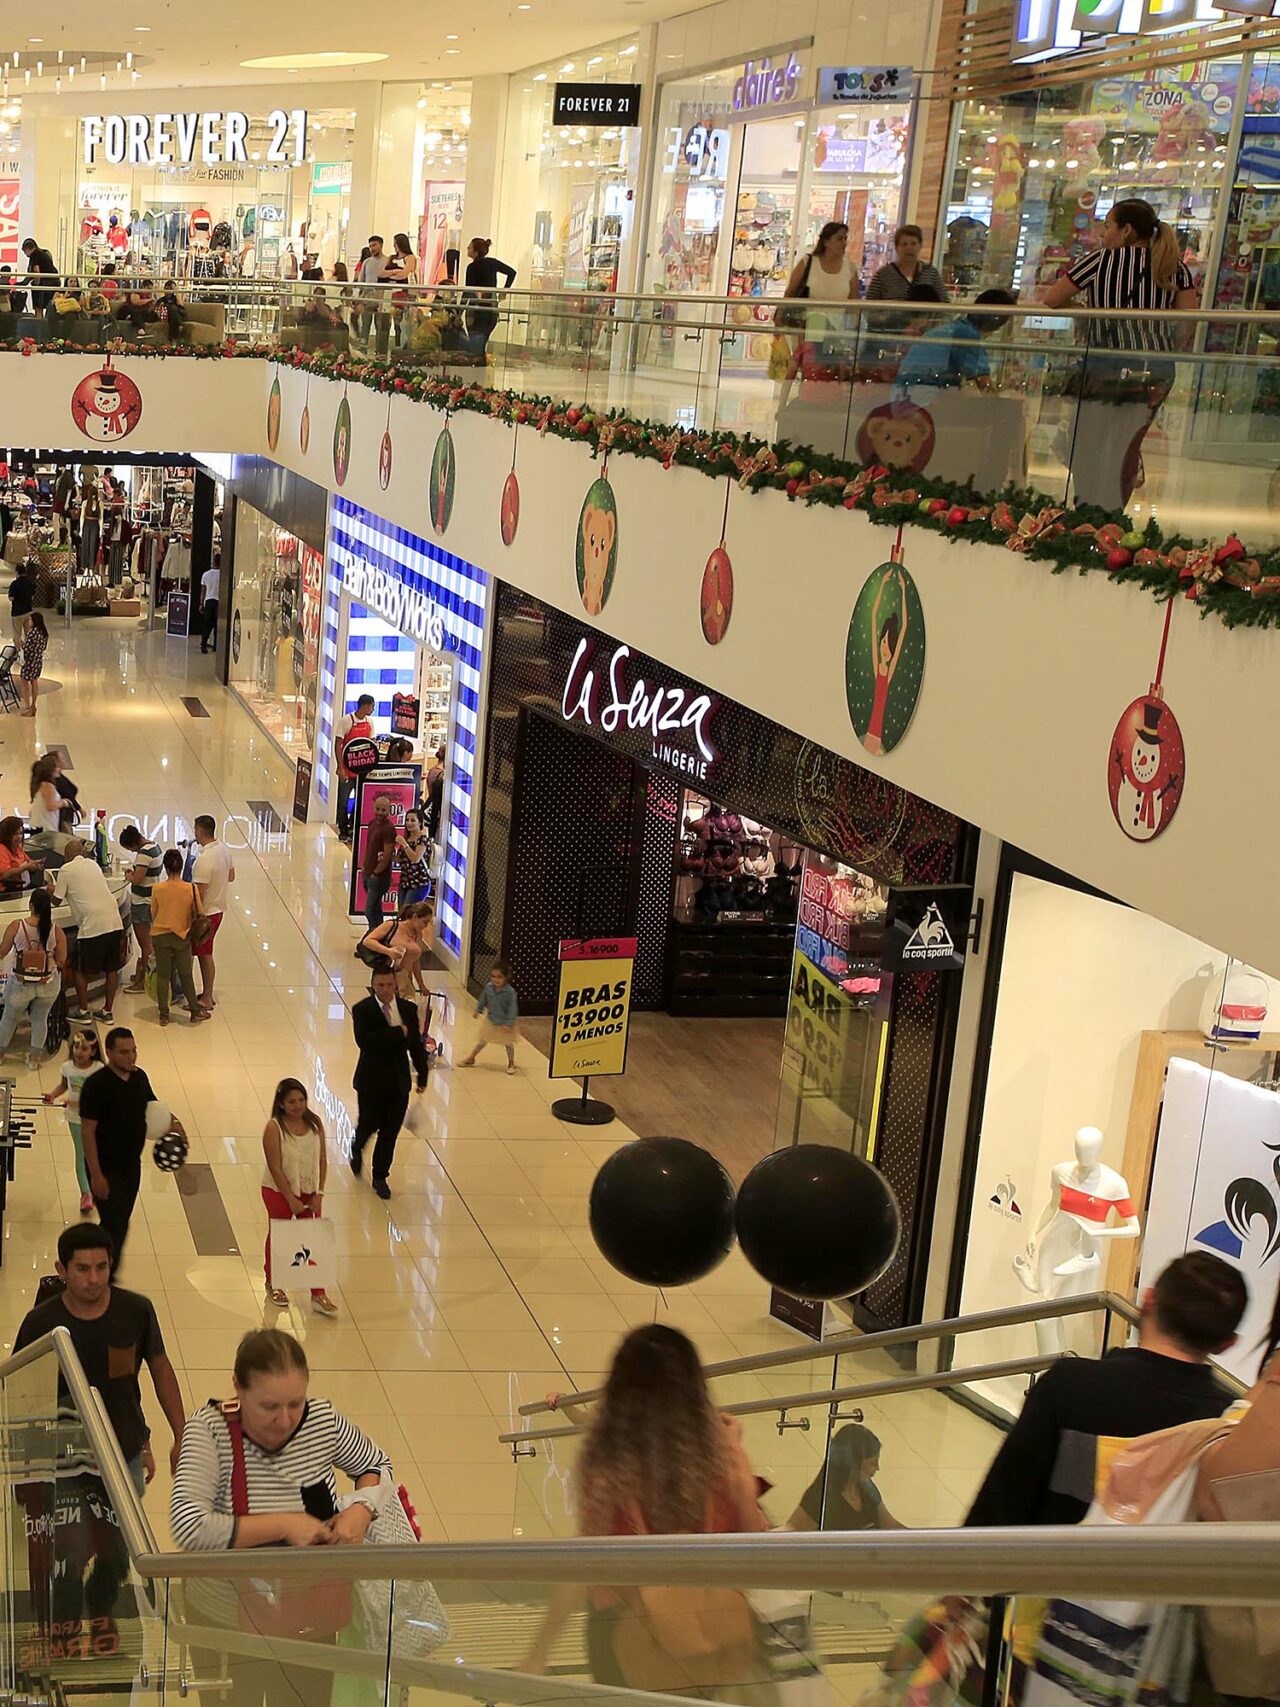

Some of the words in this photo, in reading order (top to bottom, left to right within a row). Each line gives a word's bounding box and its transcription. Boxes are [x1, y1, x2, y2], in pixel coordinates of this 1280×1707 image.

[733, 53, 800, 110] claire's
[834, 71, 886, 93] TOYS
[559, 97, 612, 112] FOREVER
[618, 98, 630, 112] 21
[1145, 91, 1183, 106] ZONA
[84, 111, 250, 165] FOREVER
[267, 110, 307, 161] 21
[208, 169, 244, 181] FASHION
[601, 645, 713, 762] Senza
[347, 749, 375, 760] BLACK
[348, 757, 376, 767] FRIDAY
[652, 741, 708, 780] LINGERIE
[903, 950, 910, 959] le
[911, 950, 926, 959] coq
[927, 947, 953, 959] sportif
[564, 980, 627, 1010] BRAS
[560, 1033, 571, 1044] O
[573, 1022, 623, 1042] MENOS
